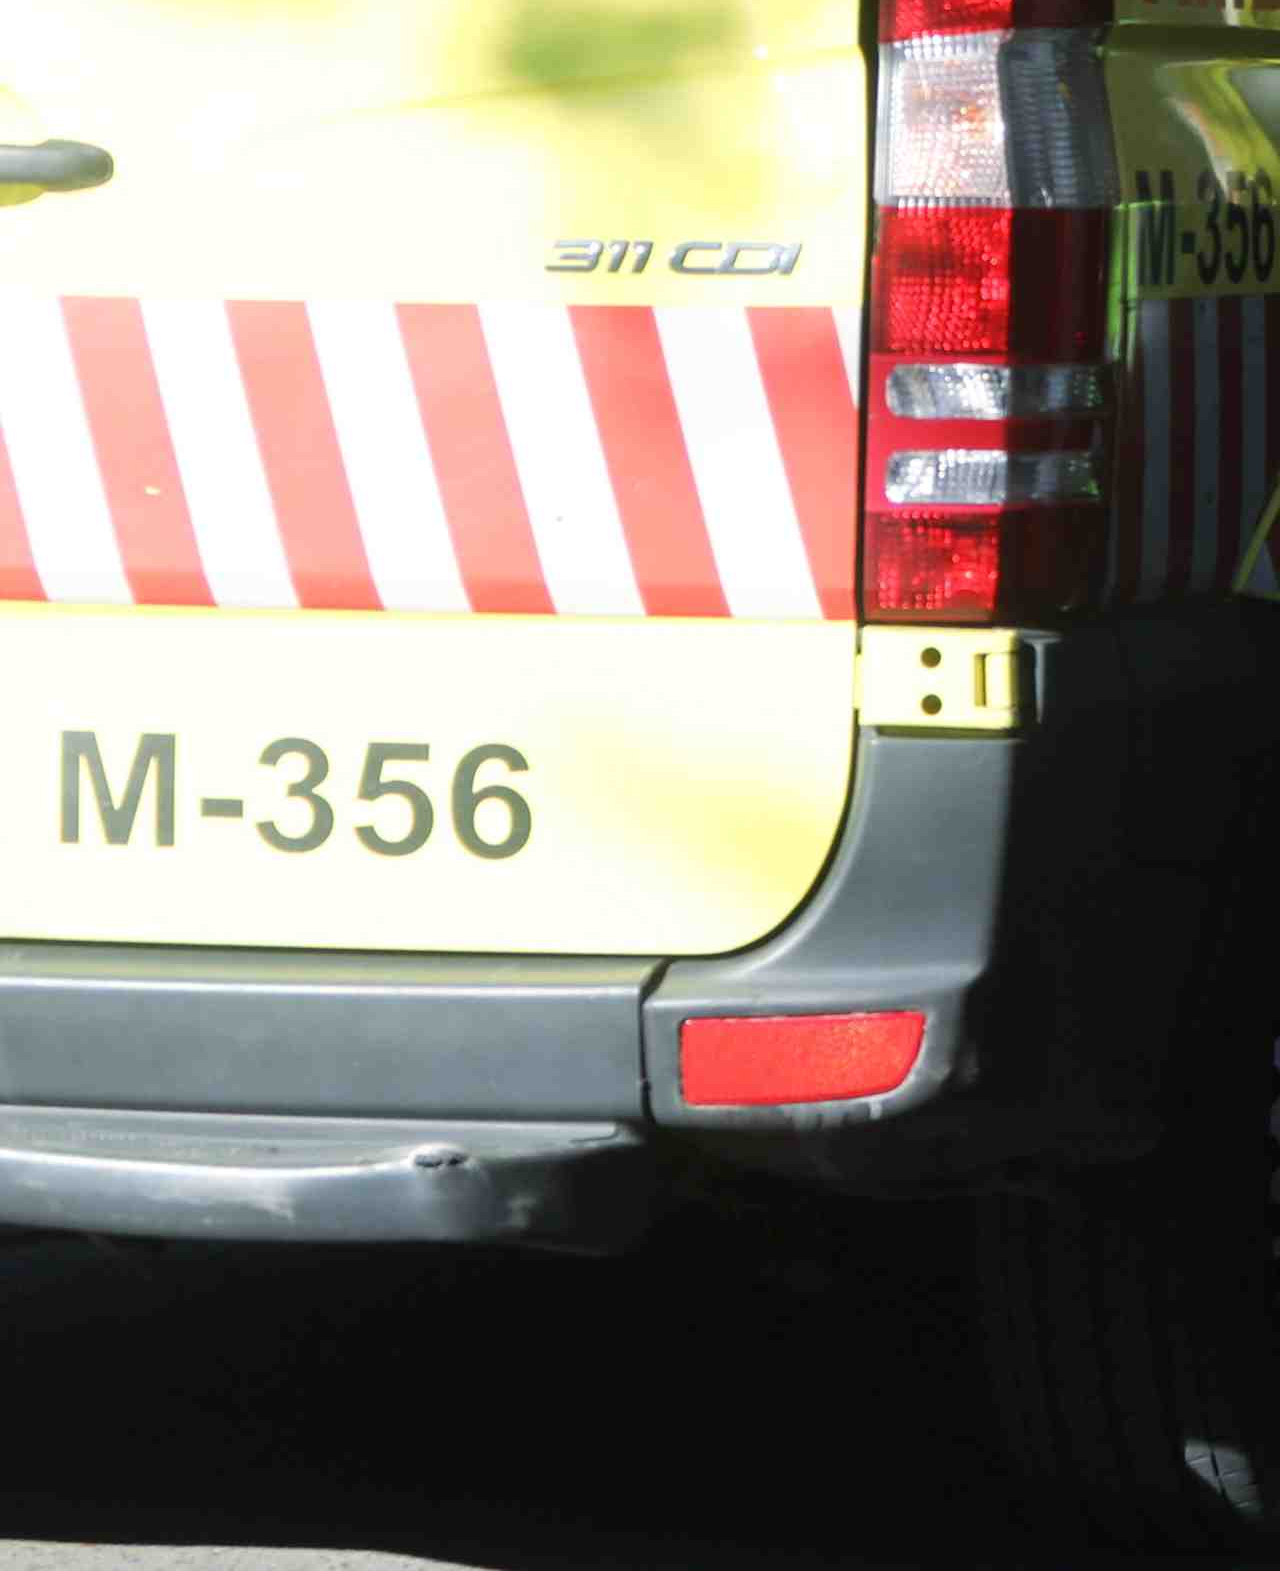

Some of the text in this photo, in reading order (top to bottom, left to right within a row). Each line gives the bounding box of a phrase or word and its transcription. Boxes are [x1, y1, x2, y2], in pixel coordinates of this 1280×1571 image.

[545, 239, 802, 276] 311 CDI
[1135, 169, 1277, 286] M-356
[59, 730, 533, 861] M-356
